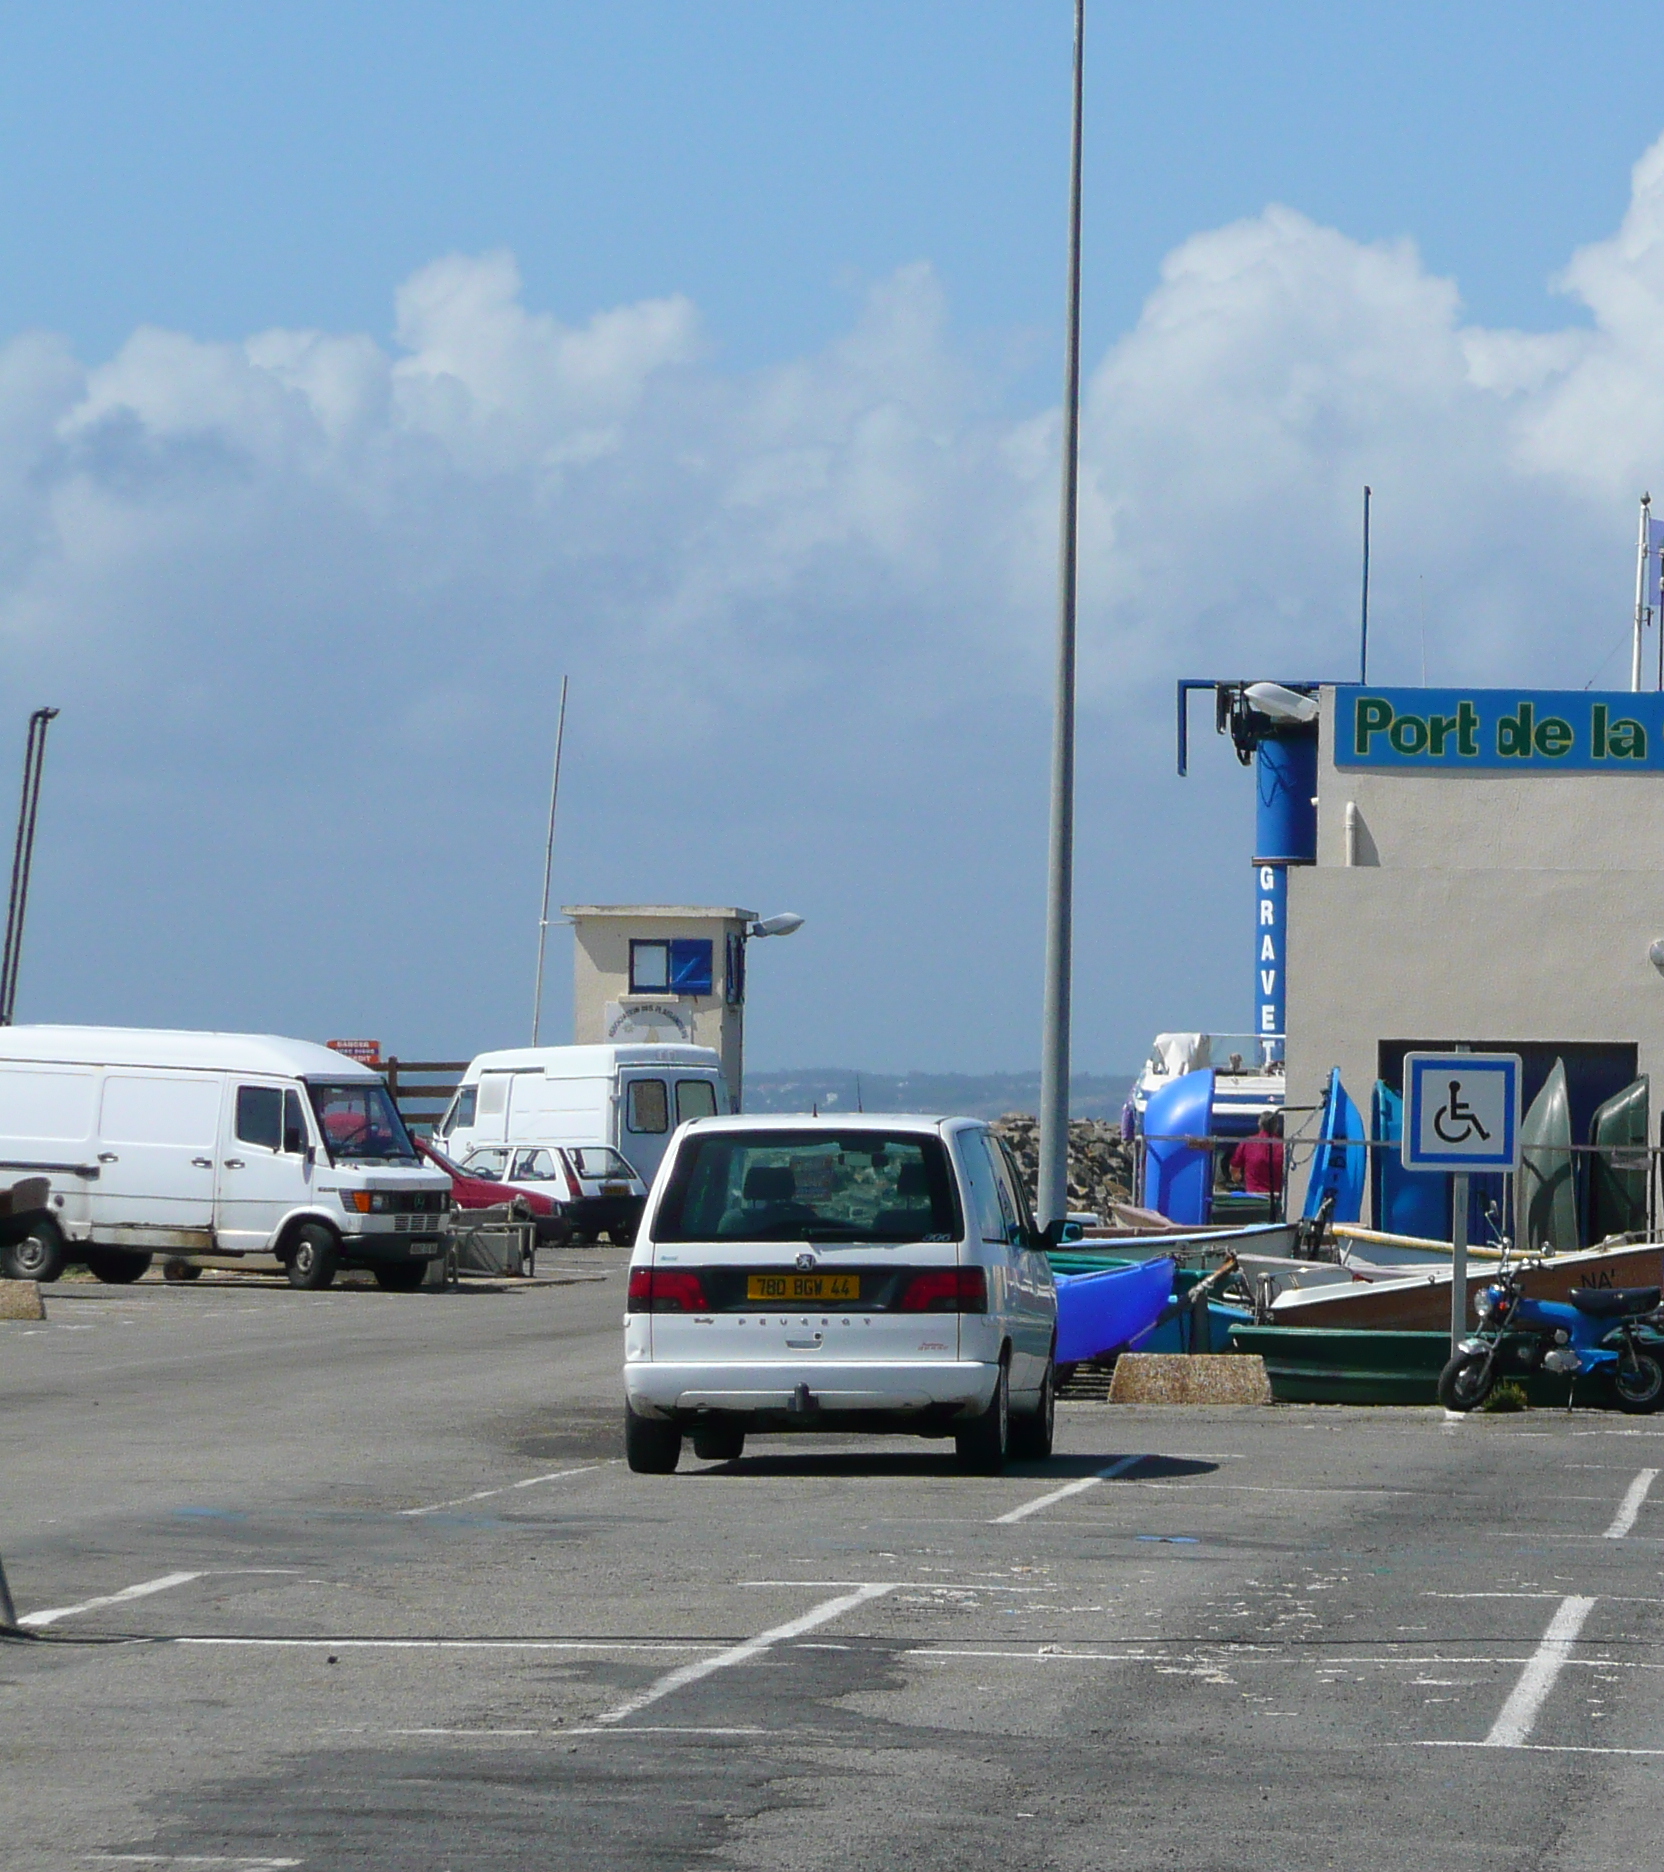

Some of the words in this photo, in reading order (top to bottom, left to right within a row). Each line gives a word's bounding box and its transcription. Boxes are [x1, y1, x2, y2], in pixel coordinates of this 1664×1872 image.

[1354, 697, 1479, 756] Port
[1496, 701, 1574, 758] de
[1591, 703, 1647, 760] la
[757, 1278, 786, 1296] 780
[793, 1278, 823, 1297] BGW
[830, 1279, 851, 1296] 44
[738, 1317, 872, 1327] PEUGEOT
